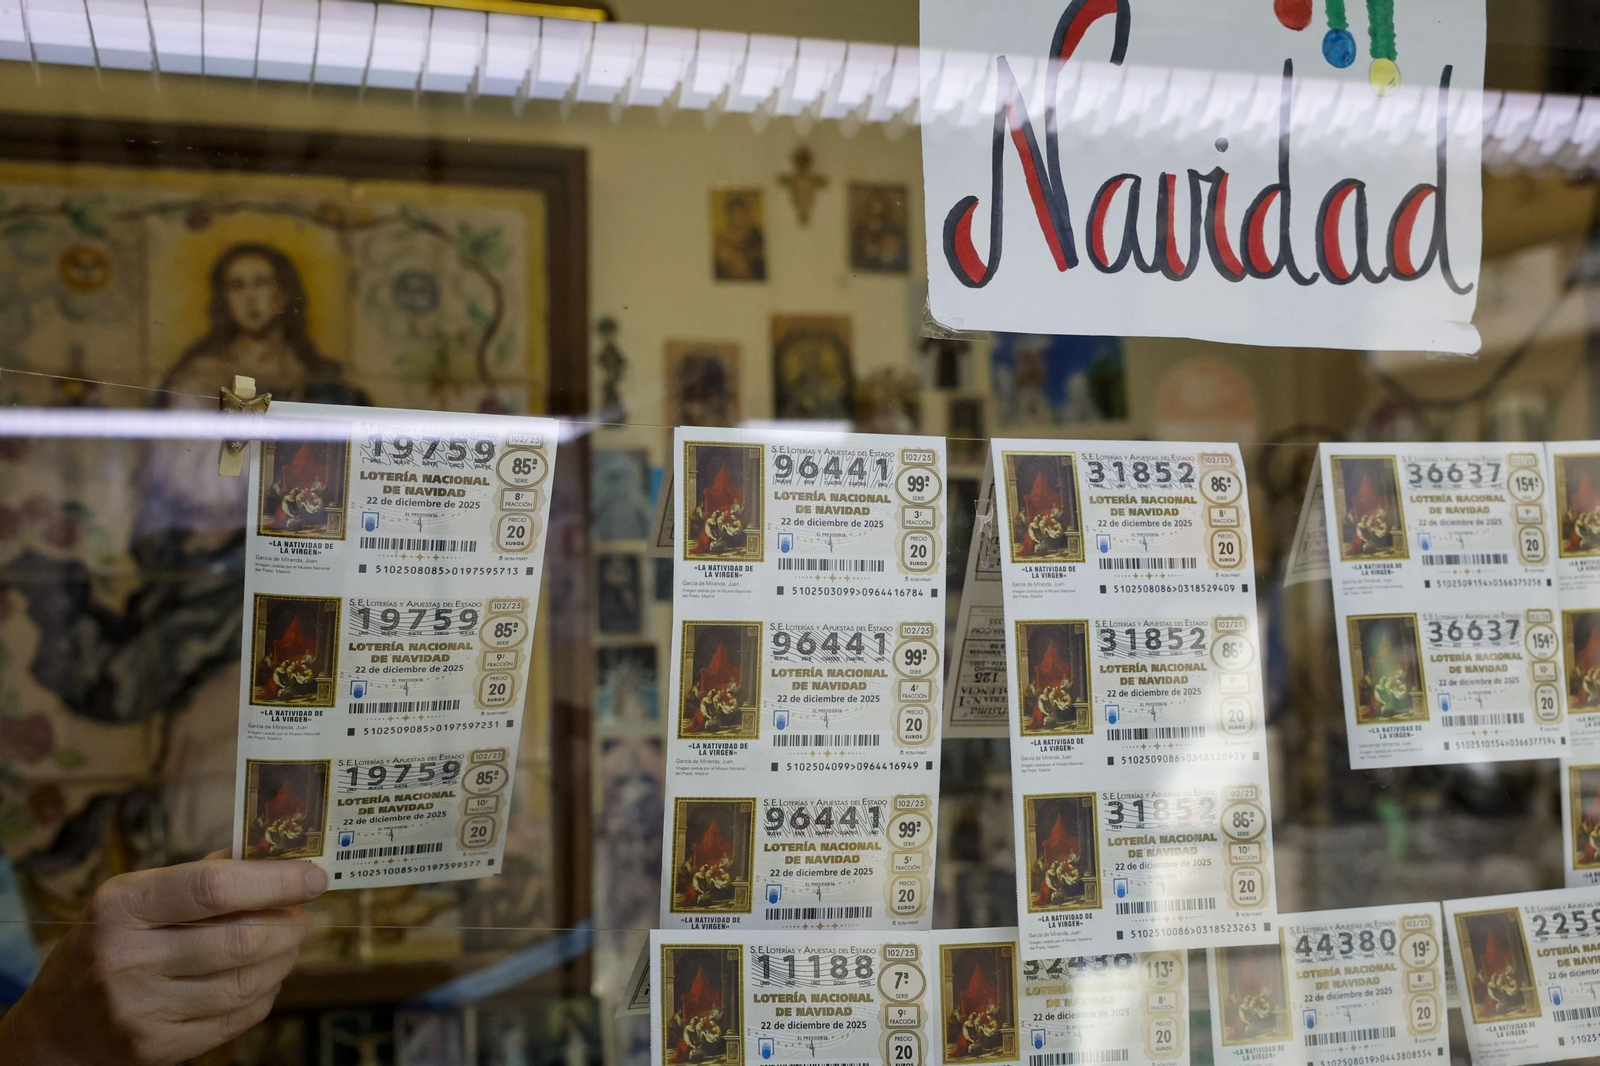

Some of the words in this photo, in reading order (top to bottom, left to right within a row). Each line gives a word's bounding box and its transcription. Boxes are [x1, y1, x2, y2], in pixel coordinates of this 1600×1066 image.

[943, 0, 1474, 295] Navidad
[370, 434, 494, 464] 19759
[775, 454, 887, 480] 96441
[1088, 461, 1194, 483] 31852
[1408, 463, 1501, 483] 36637
[360, 469, 418, 482] LOTERÍA
[422, 474, 490, 485] NACIONAL
[383, 485, 401, 494] DE
[405, 486, 466, 498] NAVIDAD
[774, 489, 826, 501] LOTERÍA
[830, 493, 891, 503] NACIONAL
[381, 497, 392, 505] de
[396, 498, 442, 507] diciembre
[444, 500, 456, 508] de
[458, 501, 480, 509] 2025
[1089, 494, 1137, 504] LOTERÍA
[1141, 496, 1197, 504] NACIONAL
[1410, 493, 1453, 503] LOTERÍA
[1455, 494, 1505, 502] NACIONAL
[795, 505, 811, 514] DE
[815, 506, 870, 515] NAVIDAD
[1110, 508, 1125, 516] DE
[1128, 508, 1179, 516] NAVIDAD
[1445, 506, 1490, 514] NAVIDAD
[507, 525, 525, 539] 20
[910, 544, 927, 558] 20
[1218, 542, 1235, 554] 20
[1525, 539, 1540, 551] 20
[358, 608, 478, 630] 19759
[1429, 620, 1520, 642] 36637
[773, 631, 885, 655] 96441
[1101, 628, 1206, 651] 31852
[349, 641, 405, 651] LOTERÍA
[408, 642, 473, 651] NACIONAL
[371, 655, 388, 663] DE
[392, 654, 450, 663] NAVIDAD
[1430, 652, 1473, 662] LOTERÍA
[1475, 652, 1523, 661] NACIONAL
[771, 667, 823, 677] LOTERÍA
[827, 669, 888, 677] NACIONAL
[1100, 662, 1148, 673] LOTERÍA
[1151, 662, 1207, 672] NACIONAL
[1448, 666, 1462, 674] DE
[1464, 664, 1508, 673] NAVIDAD
[975, 672, 998, 683] 125
[1120, 677, 1135, 685] DE
[1138, 675, 1189, 685] NAVIDAD
[488, 683, 506, 695] 20
[792, 682, 808, 690] DE
[812, 682, 867, 690] NAVIDAD
[1118, 689, 1128, 697] de
[1131, 688, 1170, 696] diciembre
[1171, 688, 1181, 696] de
[1540, 697, 1554, 709] 20
[906, 718, 922, 731] 20
[347, 761, 461, 786] 19759
[338, 794, 391, 806] LOTERÍA
[394, 790, 456, 802] NACIONAL
[358, 807, 374, 815] DE
[378, 802, 434, 813] NAVIDAD
[1108, 798, 1216, 824] 31852
[369, 814, 412, 823] diciembre
[766, 805, 879, 830] 96441
[470, 826, 487, 837] 20
[1108, 833, 1156, 847] LOTERÍA
[1159, 832, 1217, 844] NACIONAL
[764, 841, 816, 852] LOTERÍA
[820, 842, 881, 851] NACIONAL
[785, 856, 801, 864] DE
[805, 855, 860, 864] NAVIDAD
[1128, 849, 1143, 858] DE
[796, 868, 838, 876] diciembre
[1238, 879, 1255, 893] 20
[898, 889, 915, 902] 20
[1296, 929, 1396, 956] 44380
[887, 949, 914, 957] 102/25
[1536, 943, 1580, 957] LOTERÍA
[758, 955, 873, 979] 11188
[1556, 958, 1571, 967] DE
[1296, 965, 1341, 980] LOTERÍA
[1344, 962, 1397, 975] NACIONAL
[1315, 981, 1329, 990] DE
[1332, 976, 1380, 989] NAVIDAD
[754, 992, 807, 1003] LOTERÍA
[810, 993, 873, 1003] NACIONAL
[775, 1008, 792, 1016] DE
[796, 1007, 852, 1016] NAVIDAD
[1416, 1006, 1431, 1020] 20
[761, 1022, 771, 1030] 22
[774, 1021, 785, 1029] de
[788, 1021, 831, 1029] diciembre
[833, 1021, 844, 1029] de
[846, 1021, 867, 1029] 2025
[1155, 1029, 1172, 1043] 20
[895, 1045, 913, 1059] 20
